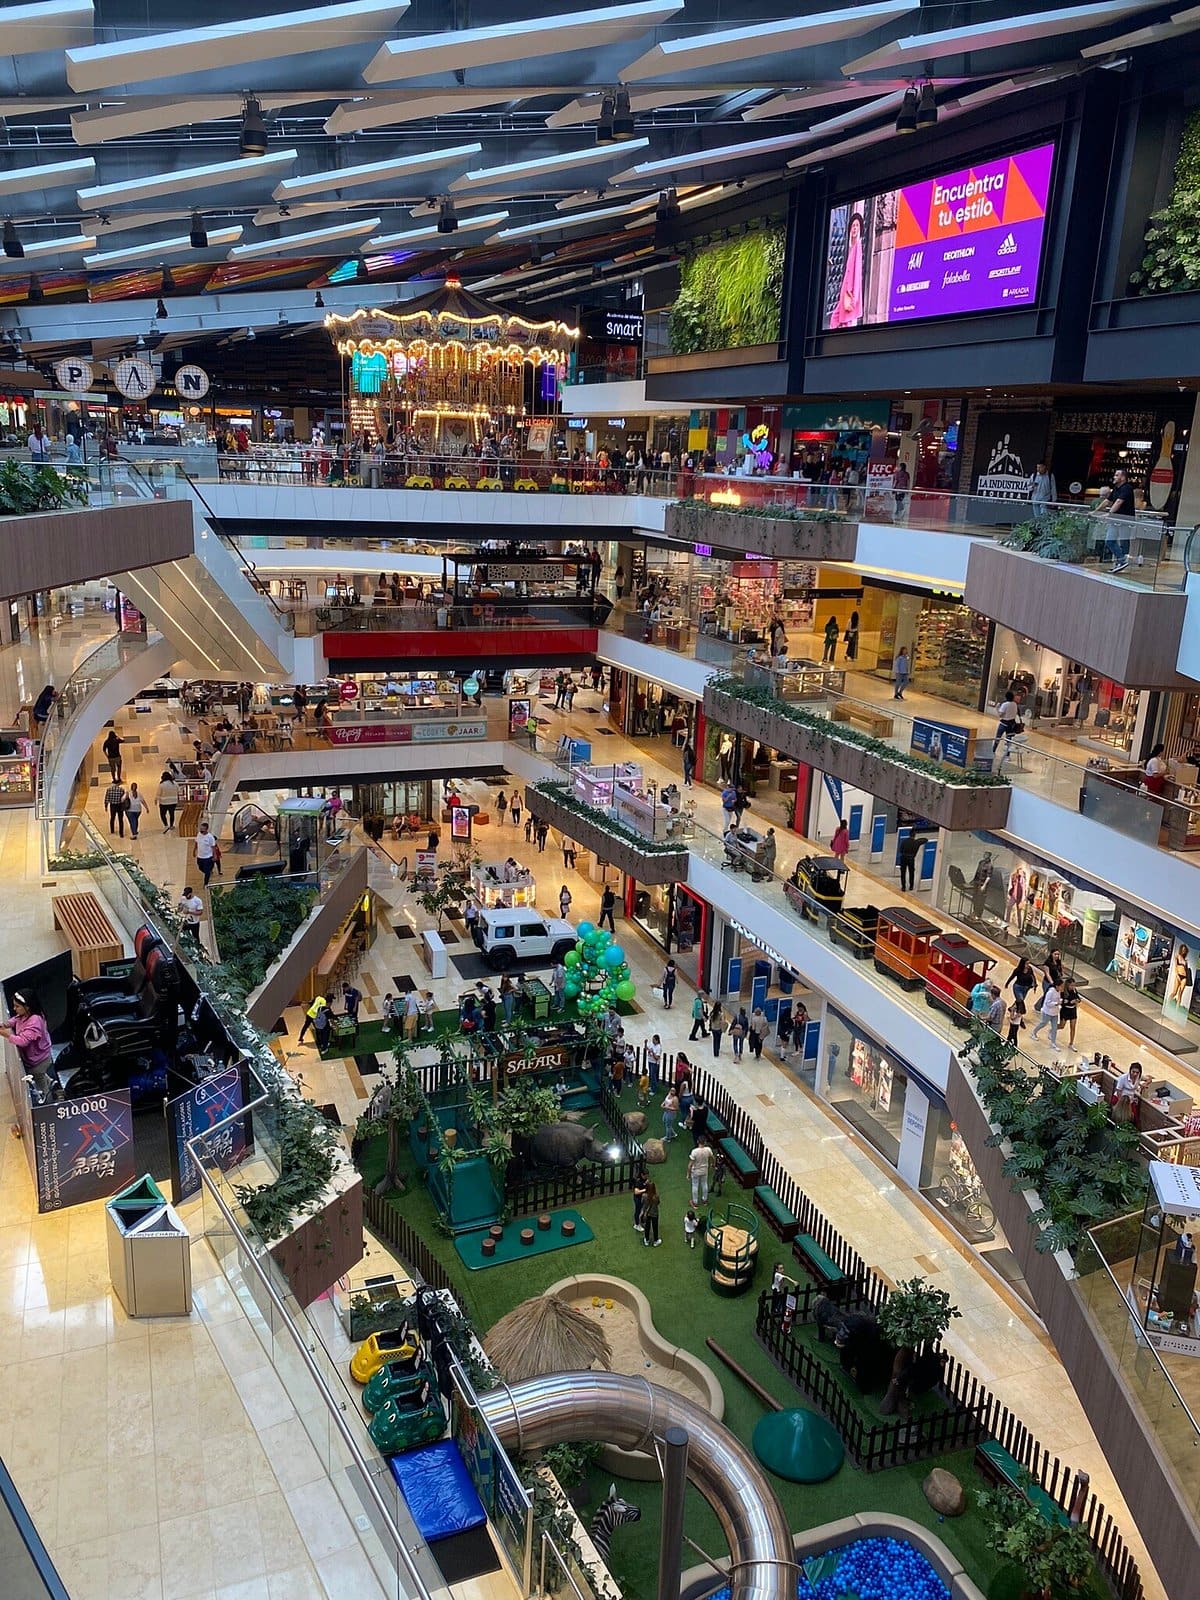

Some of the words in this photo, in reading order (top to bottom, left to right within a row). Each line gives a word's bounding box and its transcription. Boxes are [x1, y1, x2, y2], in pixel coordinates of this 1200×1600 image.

[934, 173, 1005, 206] Encuentra
[938, 209, 952, 226] tu
[955, 197, 993, 223] estilo
[943, 247, 975, 261] DECATHLON
[997, 244, 1018, 255] adidas
[942, 269, 970, 289] falabella
[1008, 287, 1029, 295] ARKADIA
[606, 320, 642, 337] smart
[870, 464, 893, 473] KFC
[979, 478, 988, 488] LA
[990, 479, 1029, 490] INDUSTRIA
[336, 727, 361, 742] Popsy
[459, 727, 479, 735] JAAR
[506, 1053, 562, 1073] SAFARI
[57, 1098, 109, 1120] $10.000
[72, 1160, 115, 1176] MOTION
[96, 1168, 115, 1179] VR
